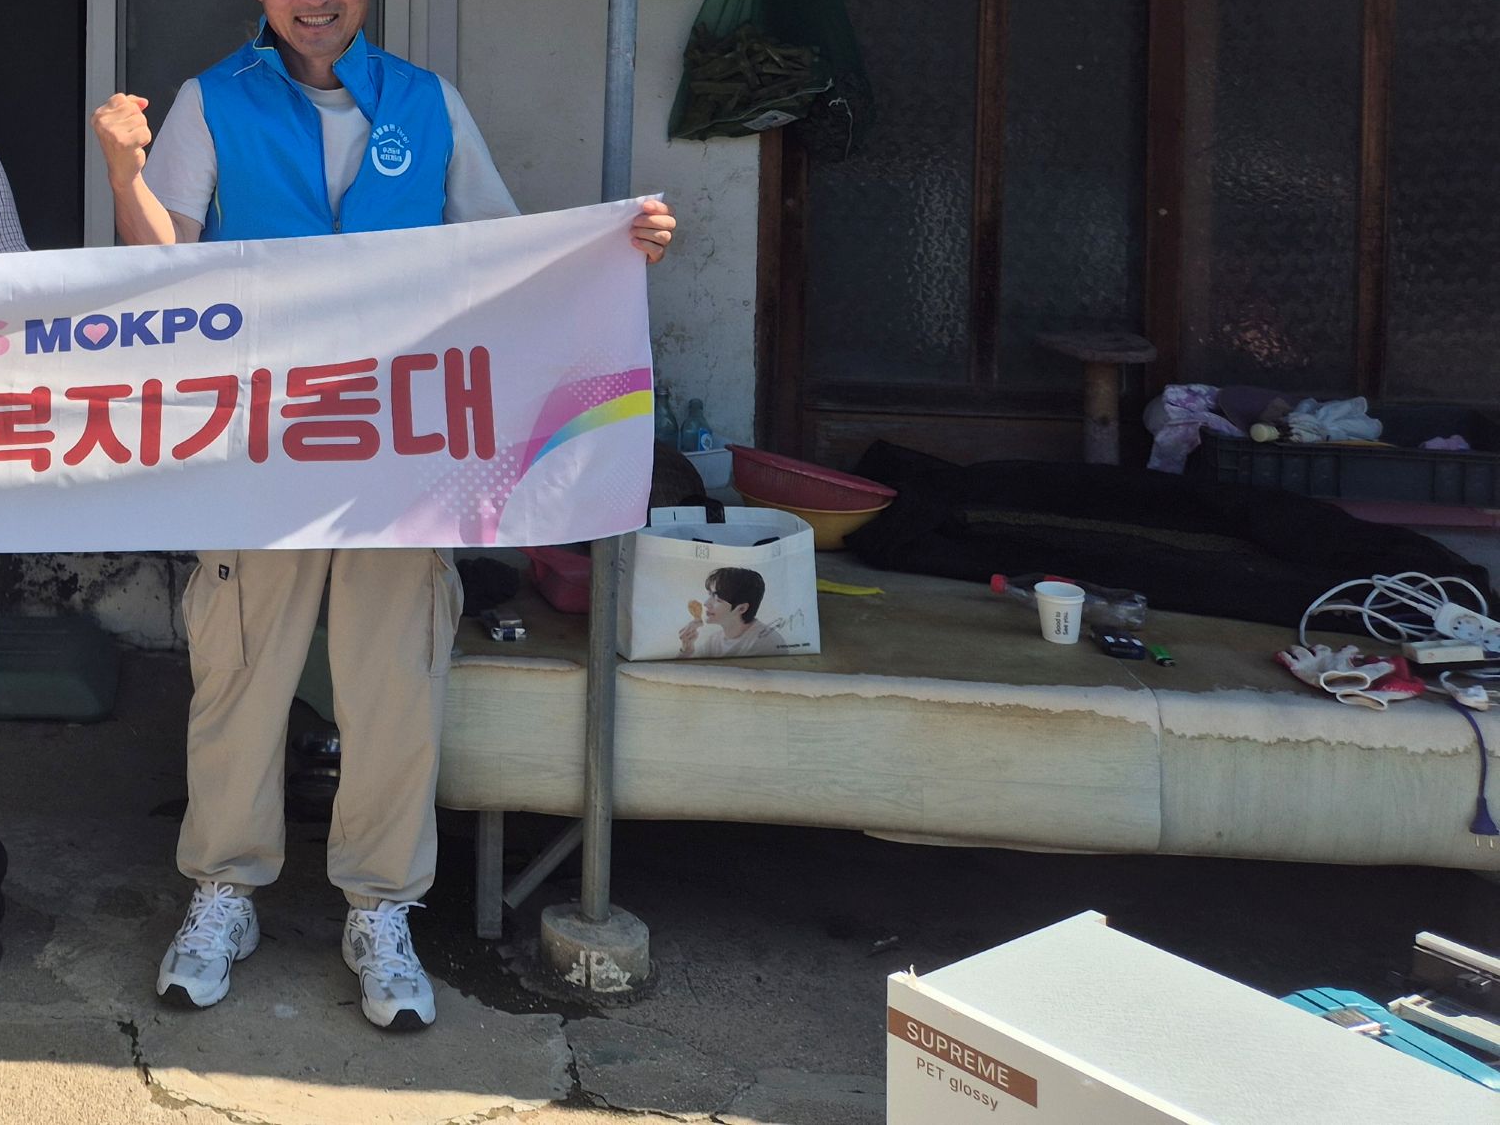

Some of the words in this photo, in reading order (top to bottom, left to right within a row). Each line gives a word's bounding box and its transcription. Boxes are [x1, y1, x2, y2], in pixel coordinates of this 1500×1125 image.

[25, 303, 243, 354] MOKPO
[906, 1021, 1009, 1088] SUPREME
[916, 1056, 945, 1081] PET
[949, 1077, 998, 1111] glossy
